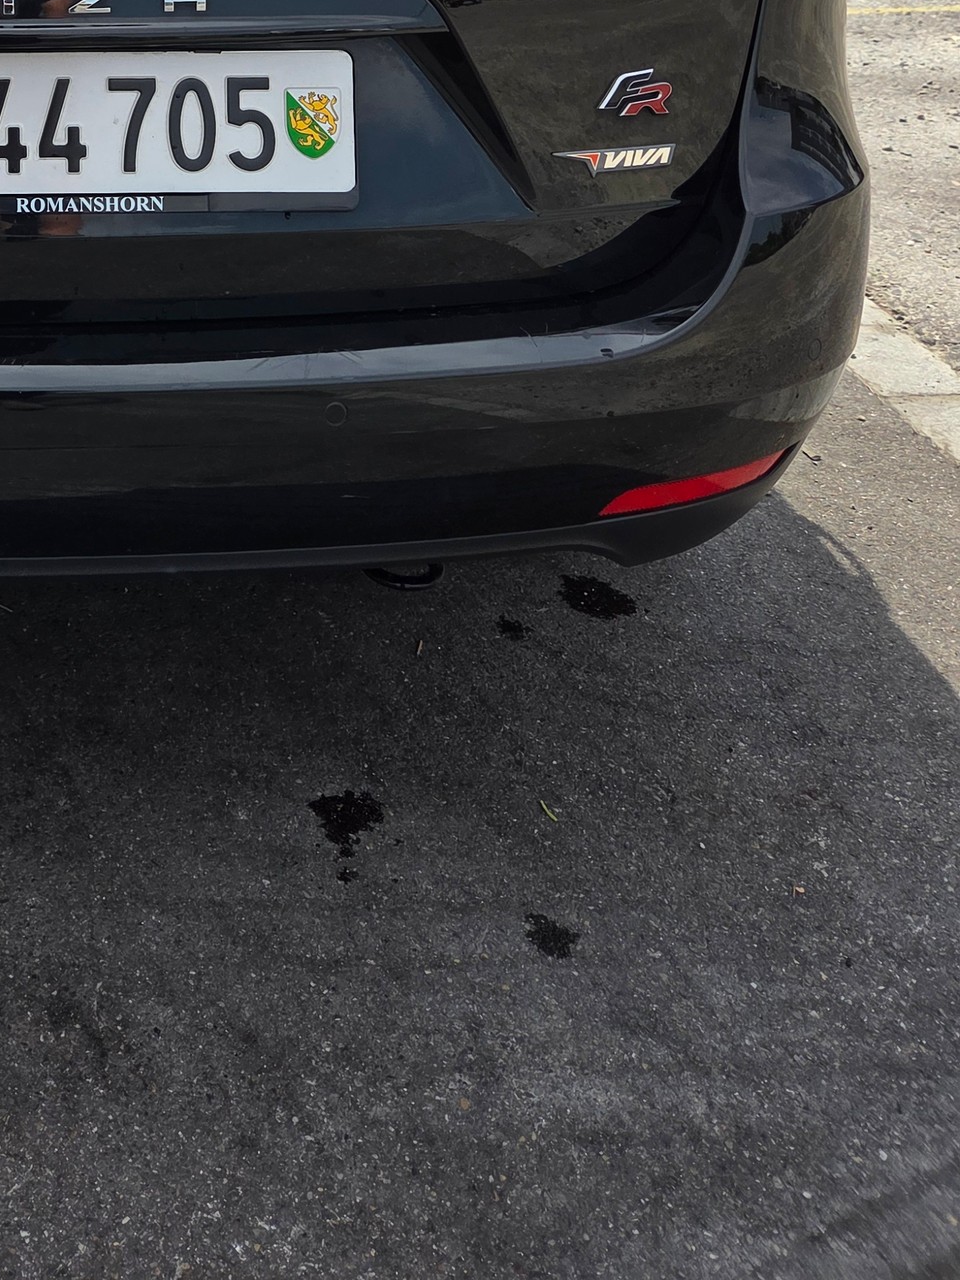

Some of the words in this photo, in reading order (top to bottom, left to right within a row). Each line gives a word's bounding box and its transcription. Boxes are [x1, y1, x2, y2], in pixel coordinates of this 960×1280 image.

[597, 68, 673, 117] FR
[603, 146, 672, 170] VIVA
[15, 195, 166, 213] ROMANSHORN
